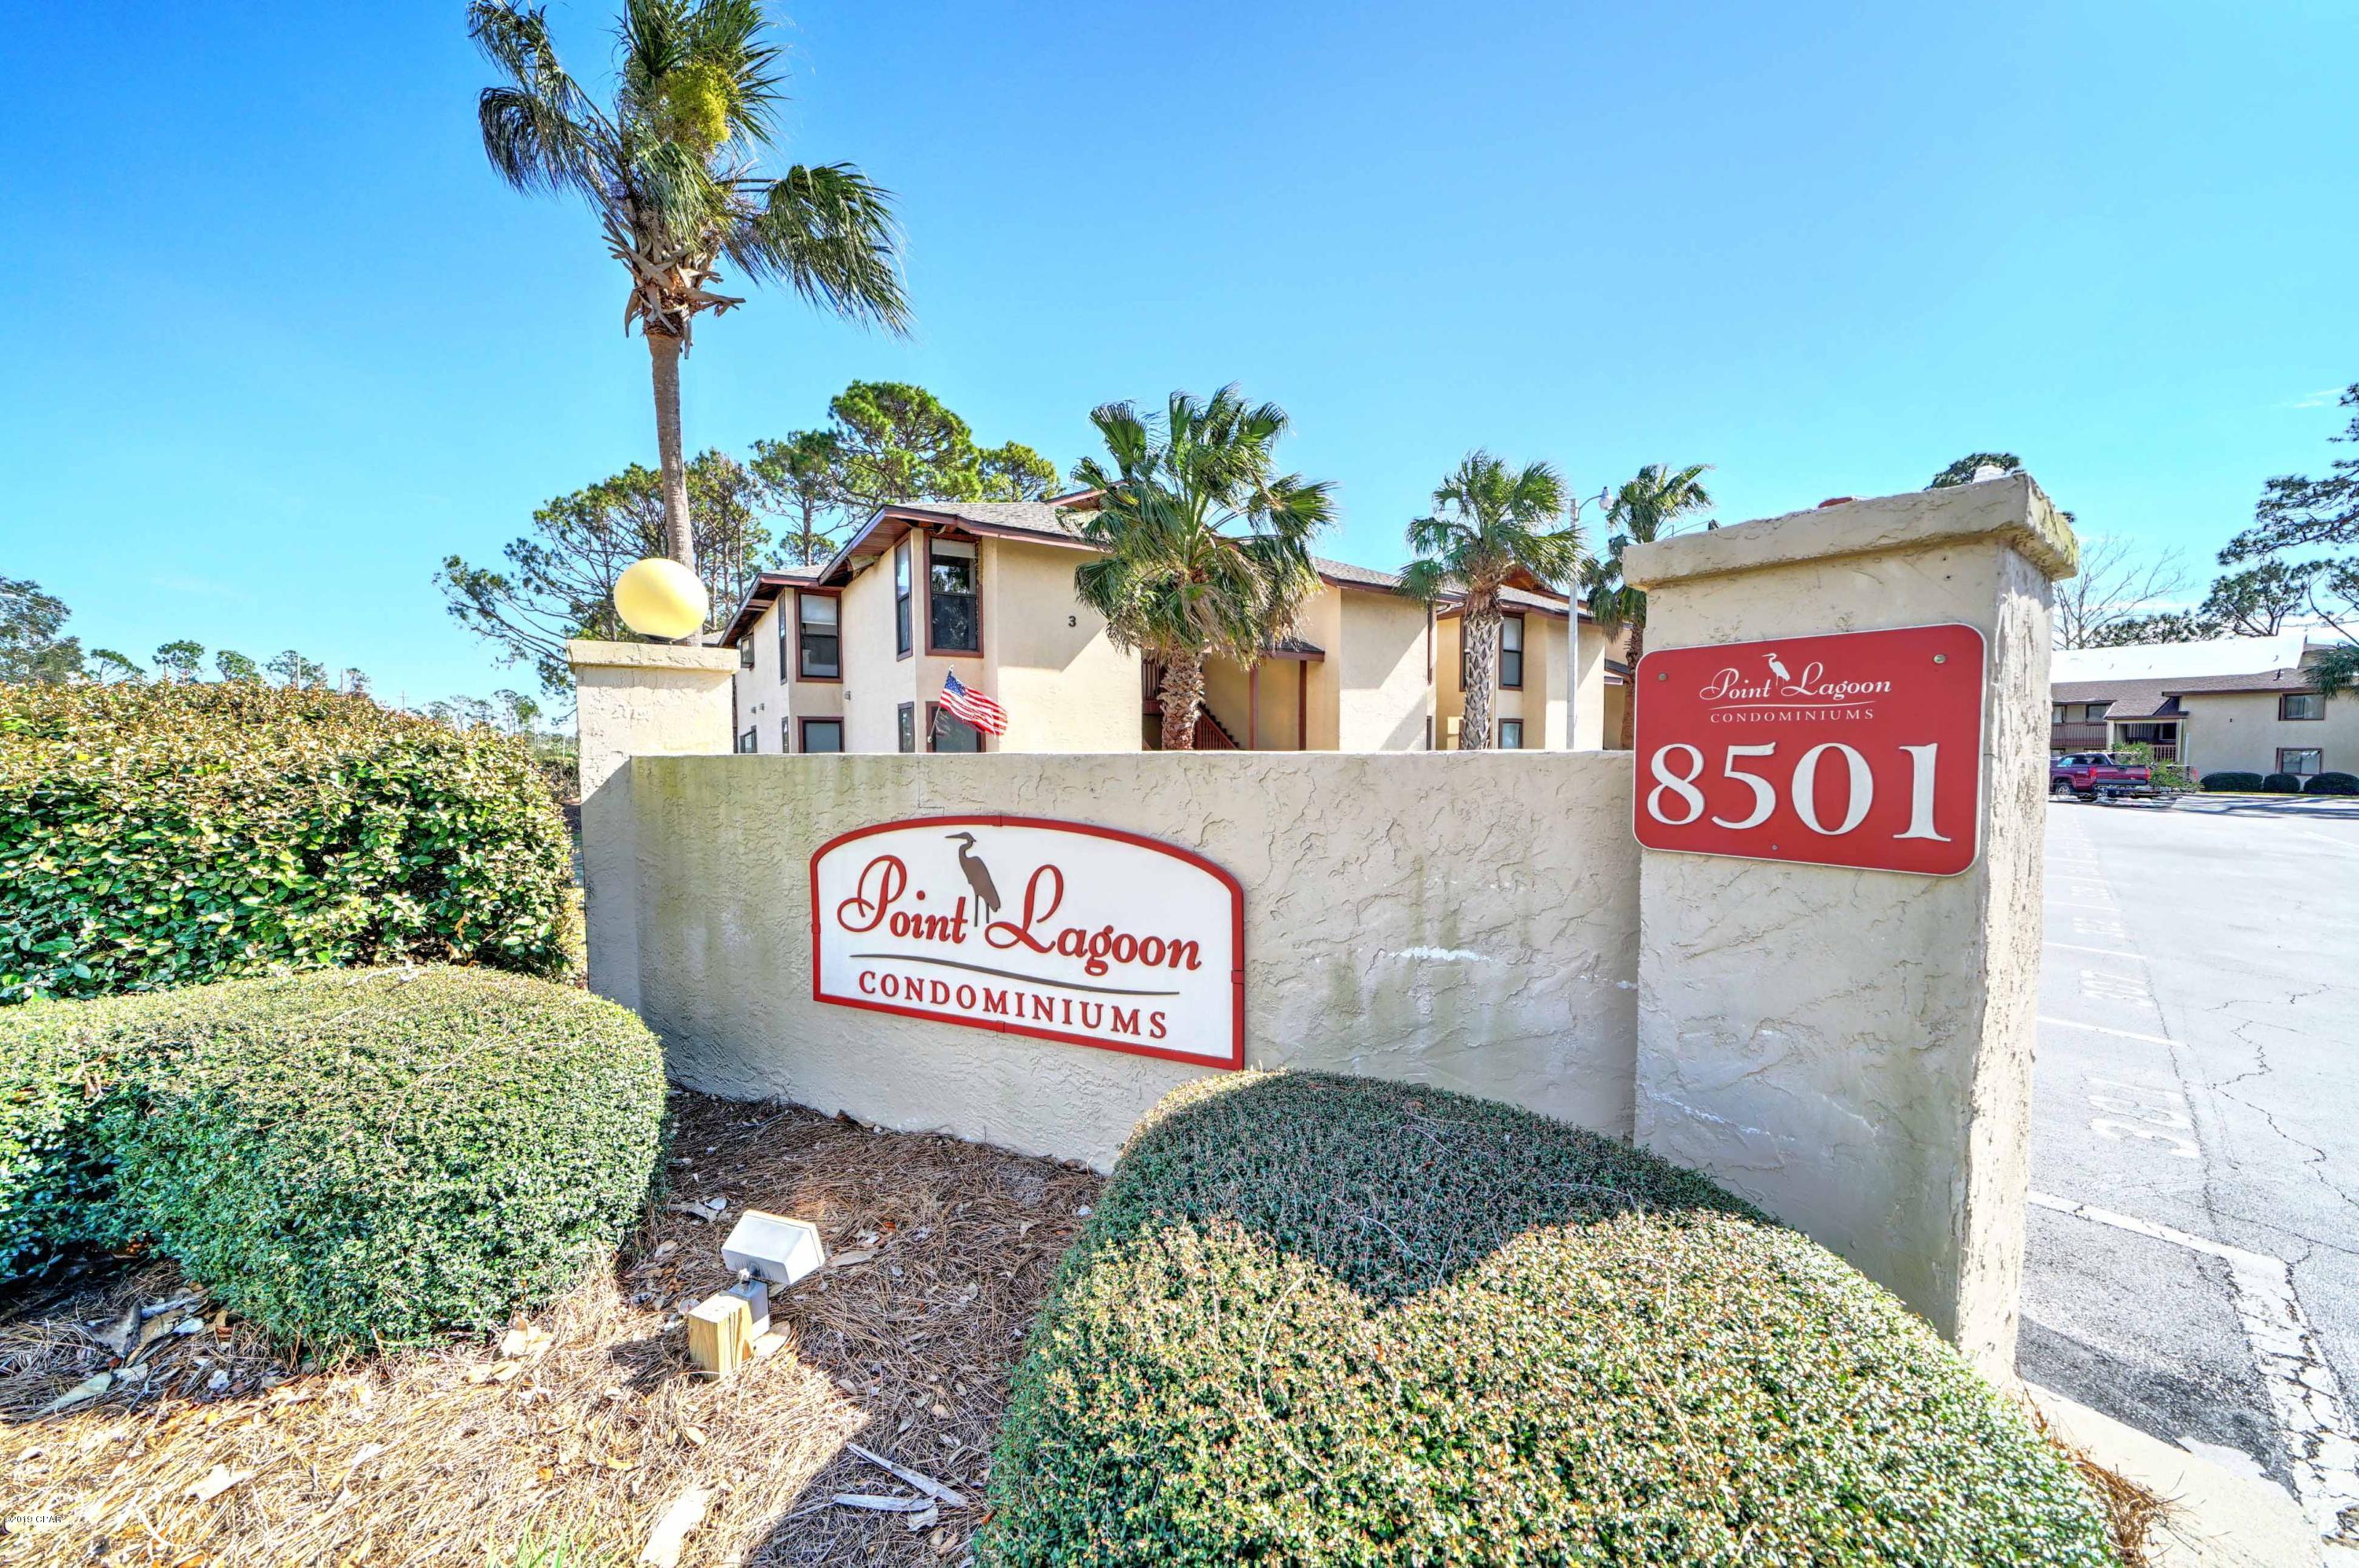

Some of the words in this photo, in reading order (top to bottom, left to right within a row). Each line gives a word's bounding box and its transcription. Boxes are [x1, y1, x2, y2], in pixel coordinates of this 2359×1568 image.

[1068, 615, 1076, 628] 3
[1699, 668, 1772, 701] Point
[1780, 661, 1892, 701] Lagoon
[1710, 709, 1875, 723] CONDOMINIUMS
[1647, 742, 1952, 842] 8501
[837, 855, 968, 944] Point
[984, 864, 1202, 977] Lagoon
[859, 970, 1167, 1040] CONDOMINIUMS
